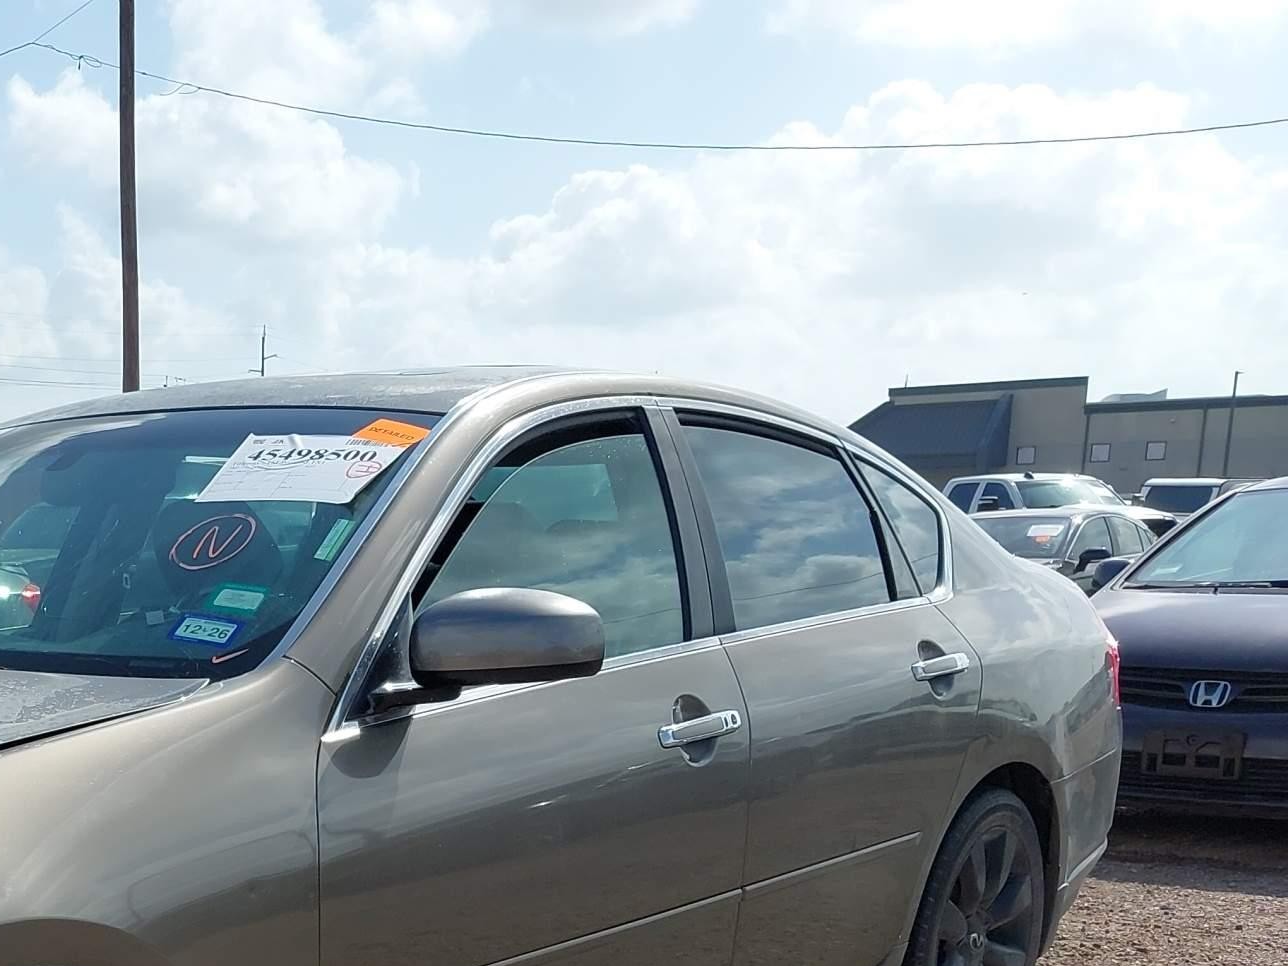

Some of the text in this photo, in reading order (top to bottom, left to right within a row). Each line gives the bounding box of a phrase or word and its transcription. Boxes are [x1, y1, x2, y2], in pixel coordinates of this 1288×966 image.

[247, 448, 377, 462] 45498500
[193, 525, 243, 559] N
[182, 623, 230, 640] 12 26
